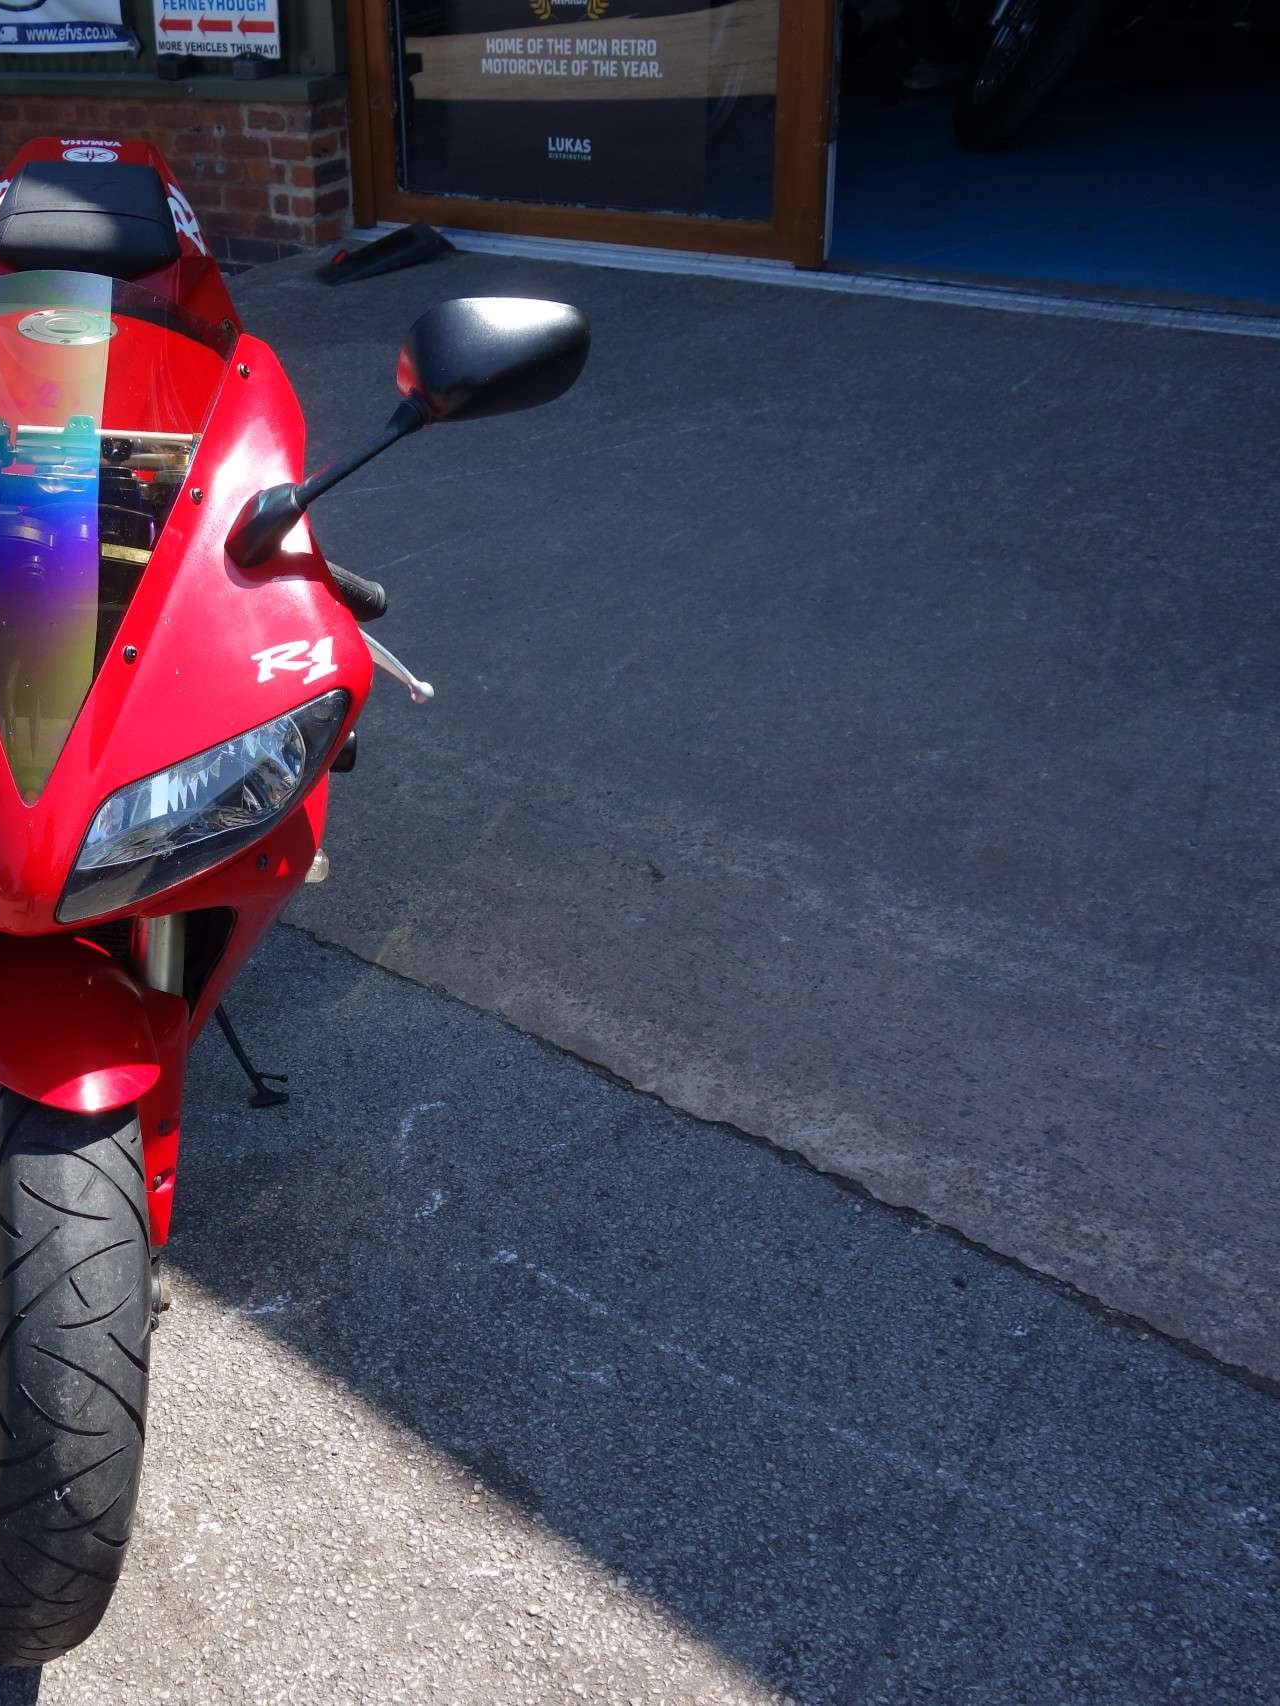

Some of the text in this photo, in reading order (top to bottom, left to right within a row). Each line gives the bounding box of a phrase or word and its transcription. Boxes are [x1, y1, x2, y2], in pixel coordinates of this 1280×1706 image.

[163, 0, 266, 12] FERNEYHOUGH
[25, 24, 117, 42] www.efvs.co.uk
[158, 41, 278, 55] MORE VEHICLES THIS WAY!
[486, 38, 657, 57] HOME OF THE MCN RETRO
[481, 58, 663, 79] MOTORCYCLE OF THE YEAR.
[60, 139, 122, 147] YAMAHA
[548, 136, 591, 153] LUKAS
[250, 636, 338, 685] R1
